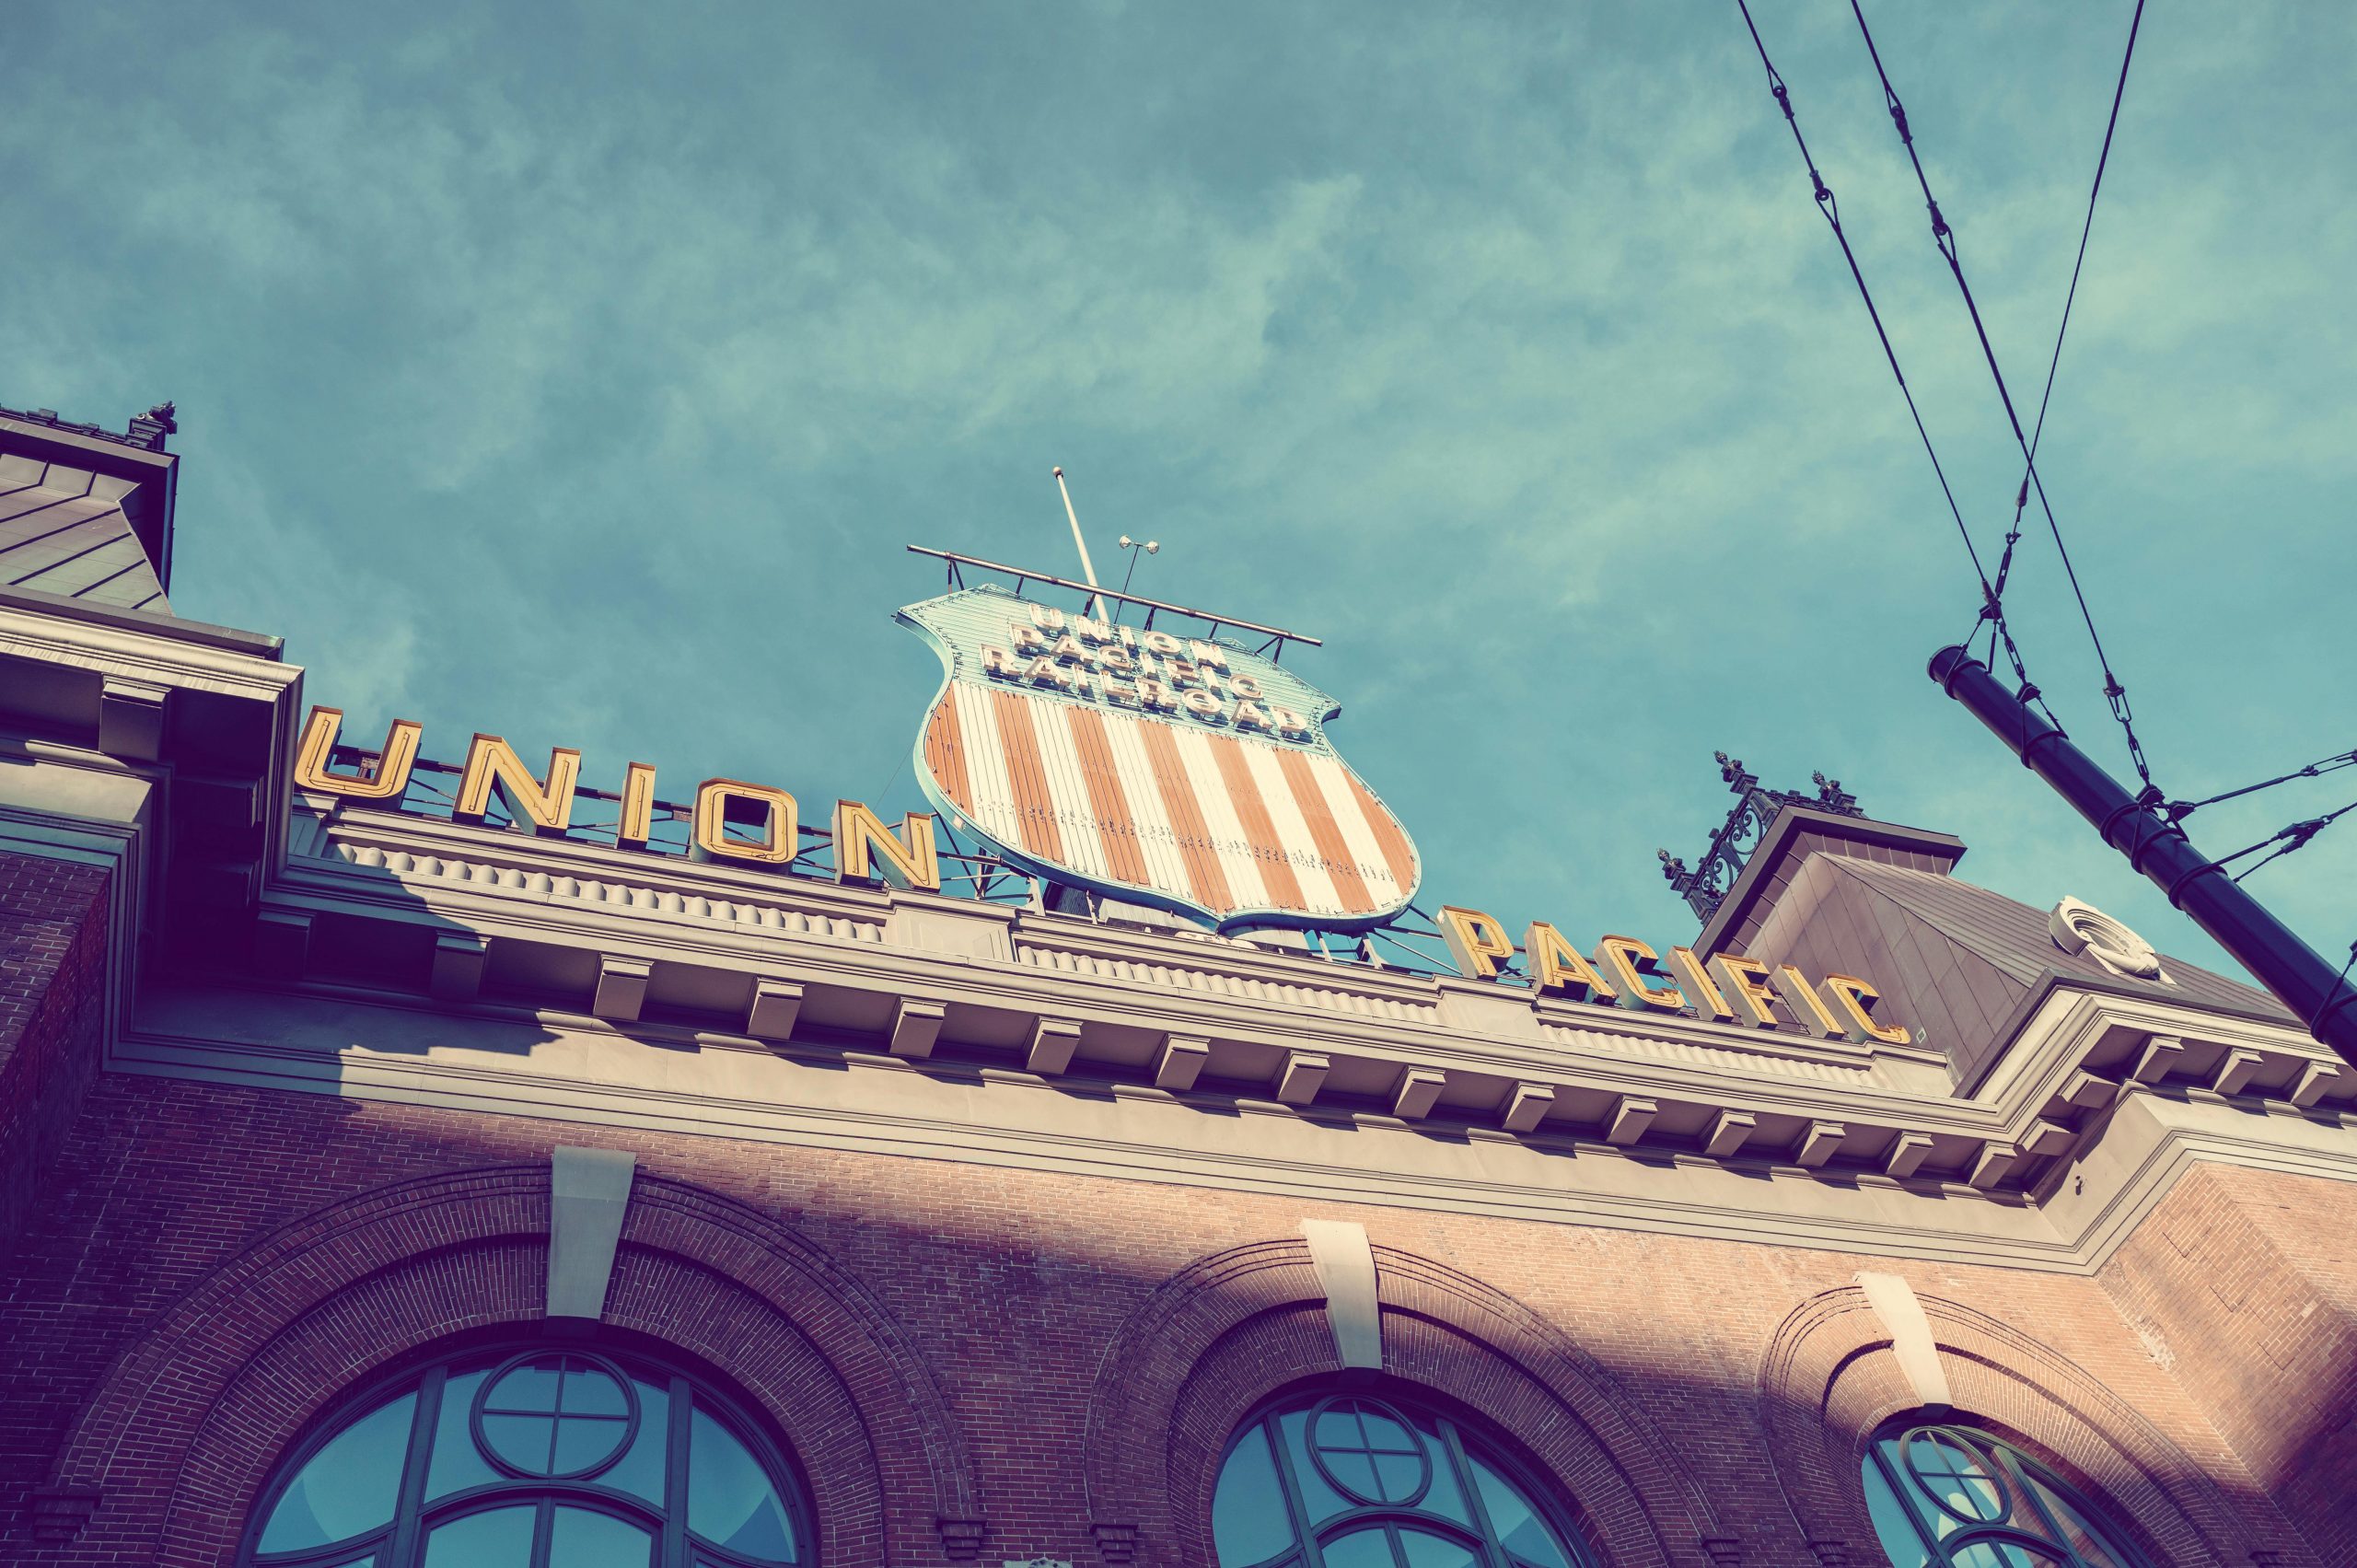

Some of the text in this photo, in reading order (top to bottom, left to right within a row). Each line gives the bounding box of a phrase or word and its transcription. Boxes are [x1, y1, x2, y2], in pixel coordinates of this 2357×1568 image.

[1010, 624, 1264, 700] PACIFIC
[1029, 605, 1226, 668] UNION
[981, 645, 1307, 733] RAILROAD
[295, 704, 1910, 1045] UNION PACIFIC
